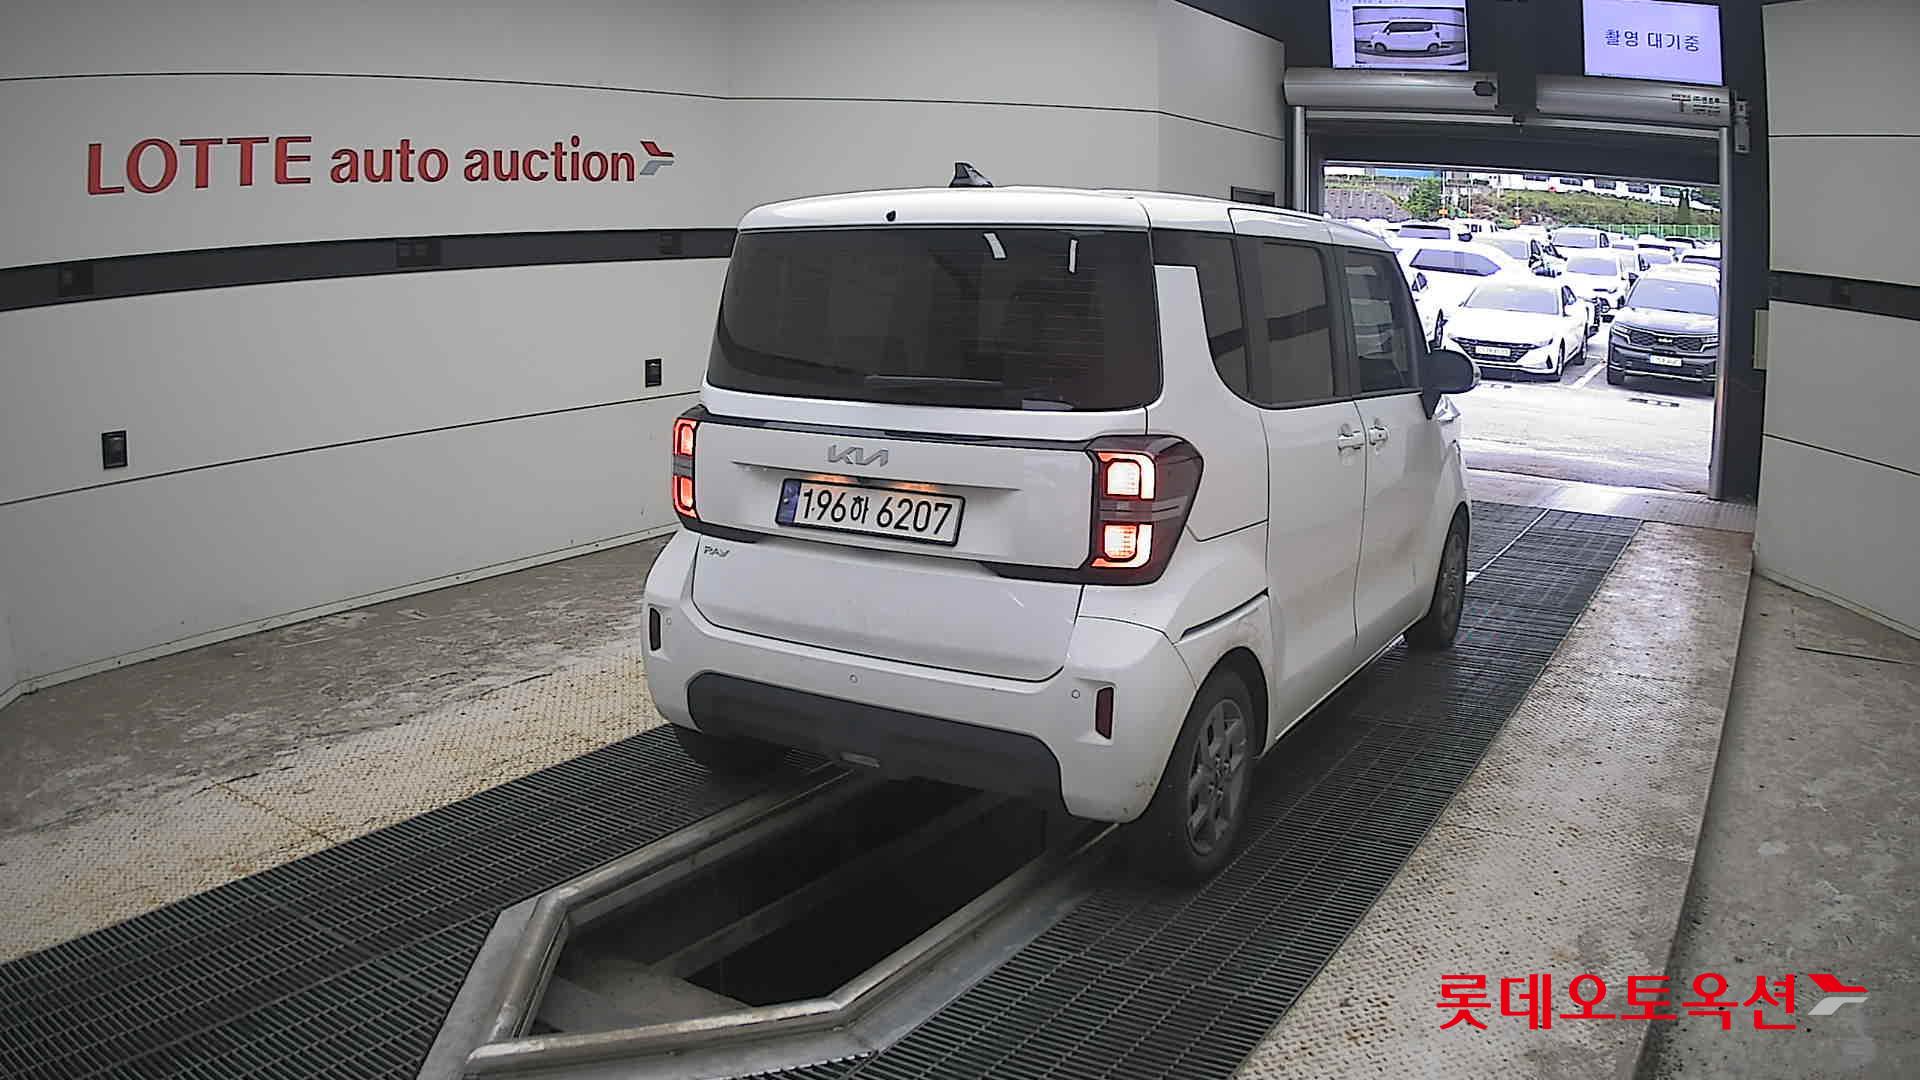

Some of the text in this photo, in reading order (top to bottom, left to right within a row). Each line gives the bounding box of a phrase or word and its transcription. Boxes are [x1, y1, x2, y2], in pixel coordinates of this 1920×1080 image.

[1605, 30, 1700, 52] 촬영 대기중
[87, 134, 637, 195] LOTTE auto auction
[828, 445, 889, 467] KIA
[803, 488, 953, 535] 196하 6207
